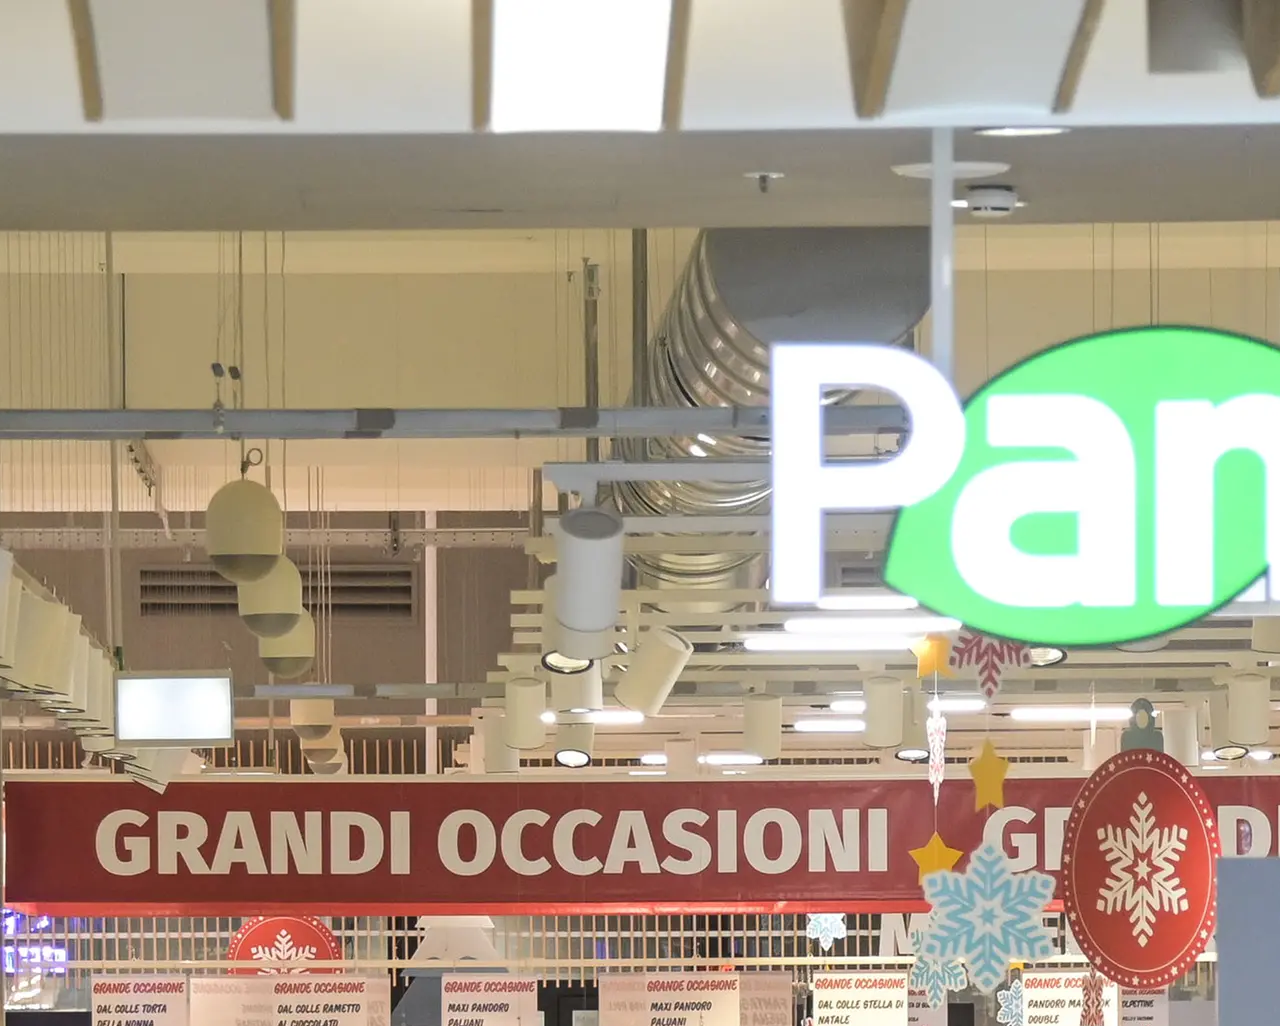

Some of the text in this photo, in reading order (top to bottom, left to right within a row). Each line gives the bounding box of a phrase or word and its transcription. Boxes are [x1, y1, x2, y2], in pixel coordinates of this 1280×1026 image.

[95, 807, 888, 877] GRANDI OCCASIONI
[93, 982, 185, 994] GRANDE OCCASIONE
[274, 981, 366, 994] GRANDE OCCASIONE
[444, 981, 535, 993] GRANDE OCCASIONE
[647, 979, 738, 992] GRANDE OCCASIONE
[815, 978, 906, 990] GRANDE OCCASIONE
[1024, 977, 1062, 989] GRANDE
[96, 1004, 167, 1014] DAL COLLE TORTA
[277, 1003, 361, 1014] DAL COLLE RAMETTO
[448, 1003, 509, 1012] MAXI PANDORO
[650, 1001, 712, 1012] MAXI PANDORO
[818, 1000, 833, 1010] DAL
[836, 1000, 861, 1009] COLLE
[863, 1000, 893, 1009] STELLA
[895, 1000, 904, 1009] DI
[1028, 999, 1065, 1009] PANDORO
[650, 1016, 687, 1026] PALUANI
[818, 1015, 850, 1025] NATALE
[1028, 1015, 1060, 1024] DOUBLE
